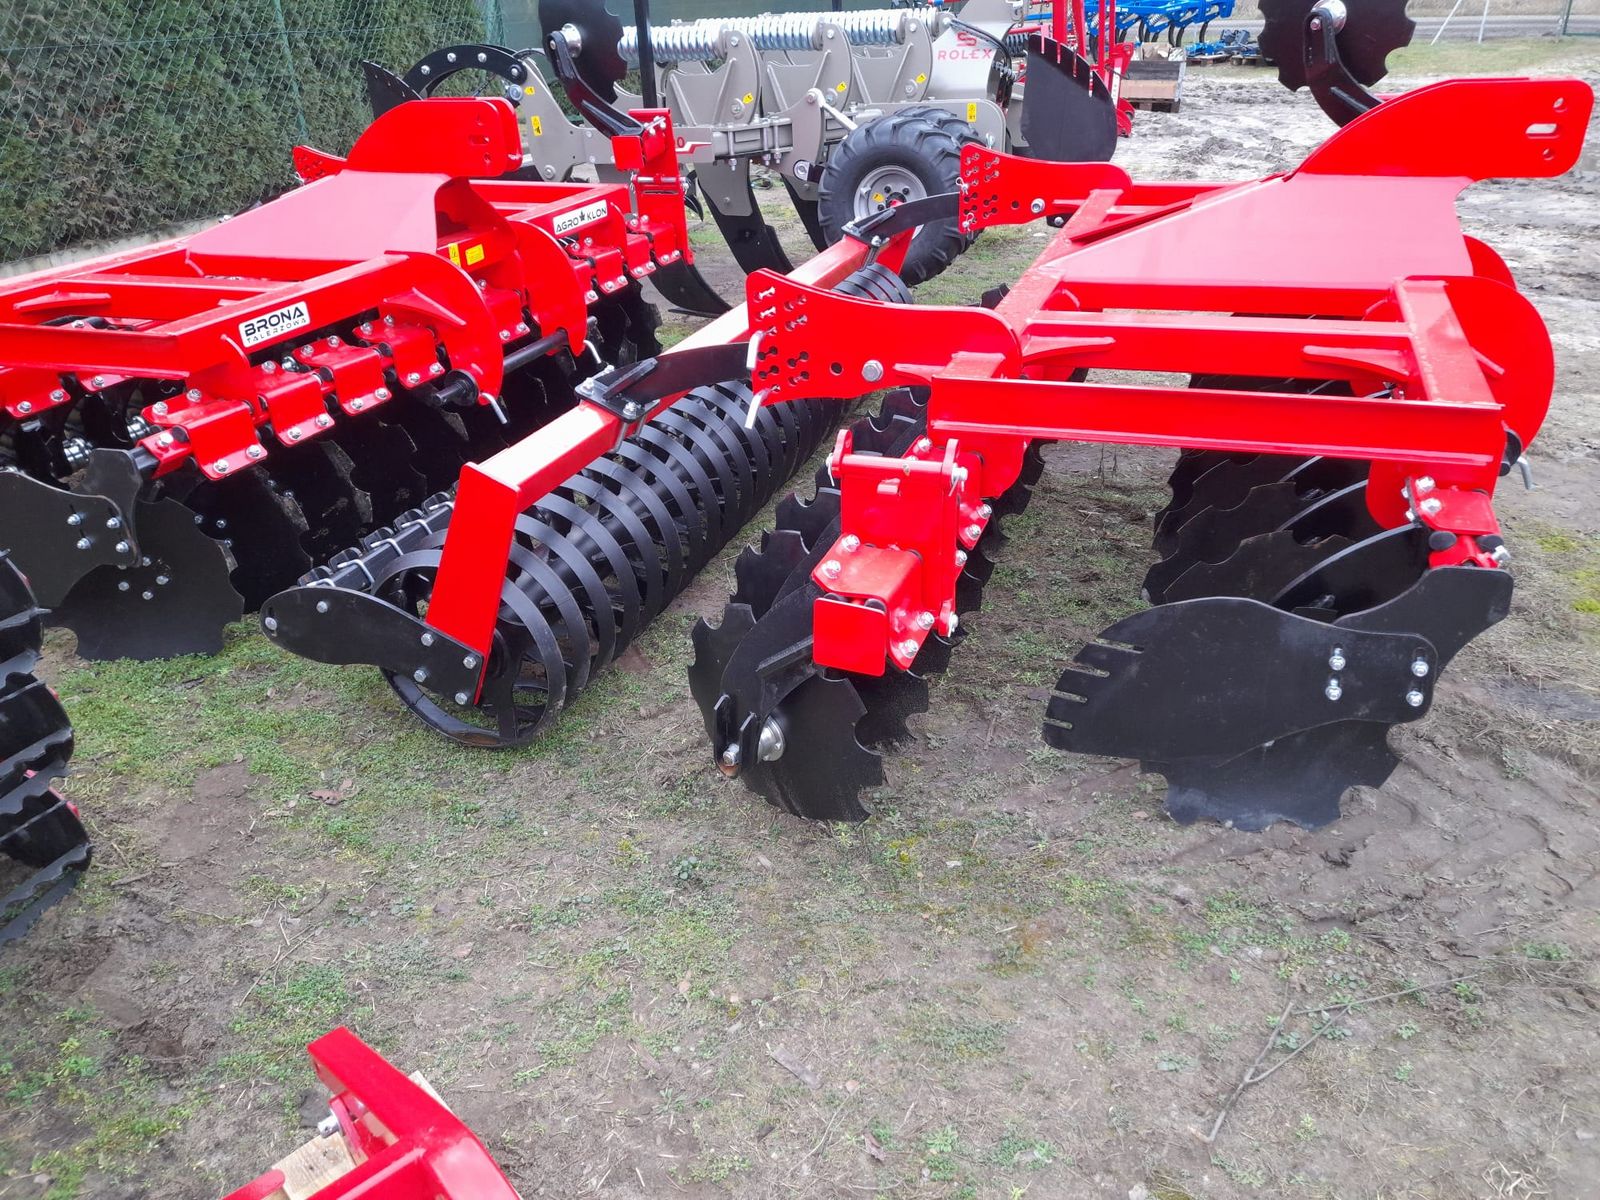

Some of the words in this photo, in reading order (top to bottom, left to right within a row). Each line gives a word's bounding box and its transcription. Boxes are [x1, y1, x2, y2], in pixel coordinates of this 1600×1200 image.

[937, 48, 992, 61] ROLEX
[556, 216, 579, 233] AGRO
[586, 207, 607, 221] KLON
[244, 306, 304, 337] BRONA
[246, 318, 306, 344] TALERZOWA
